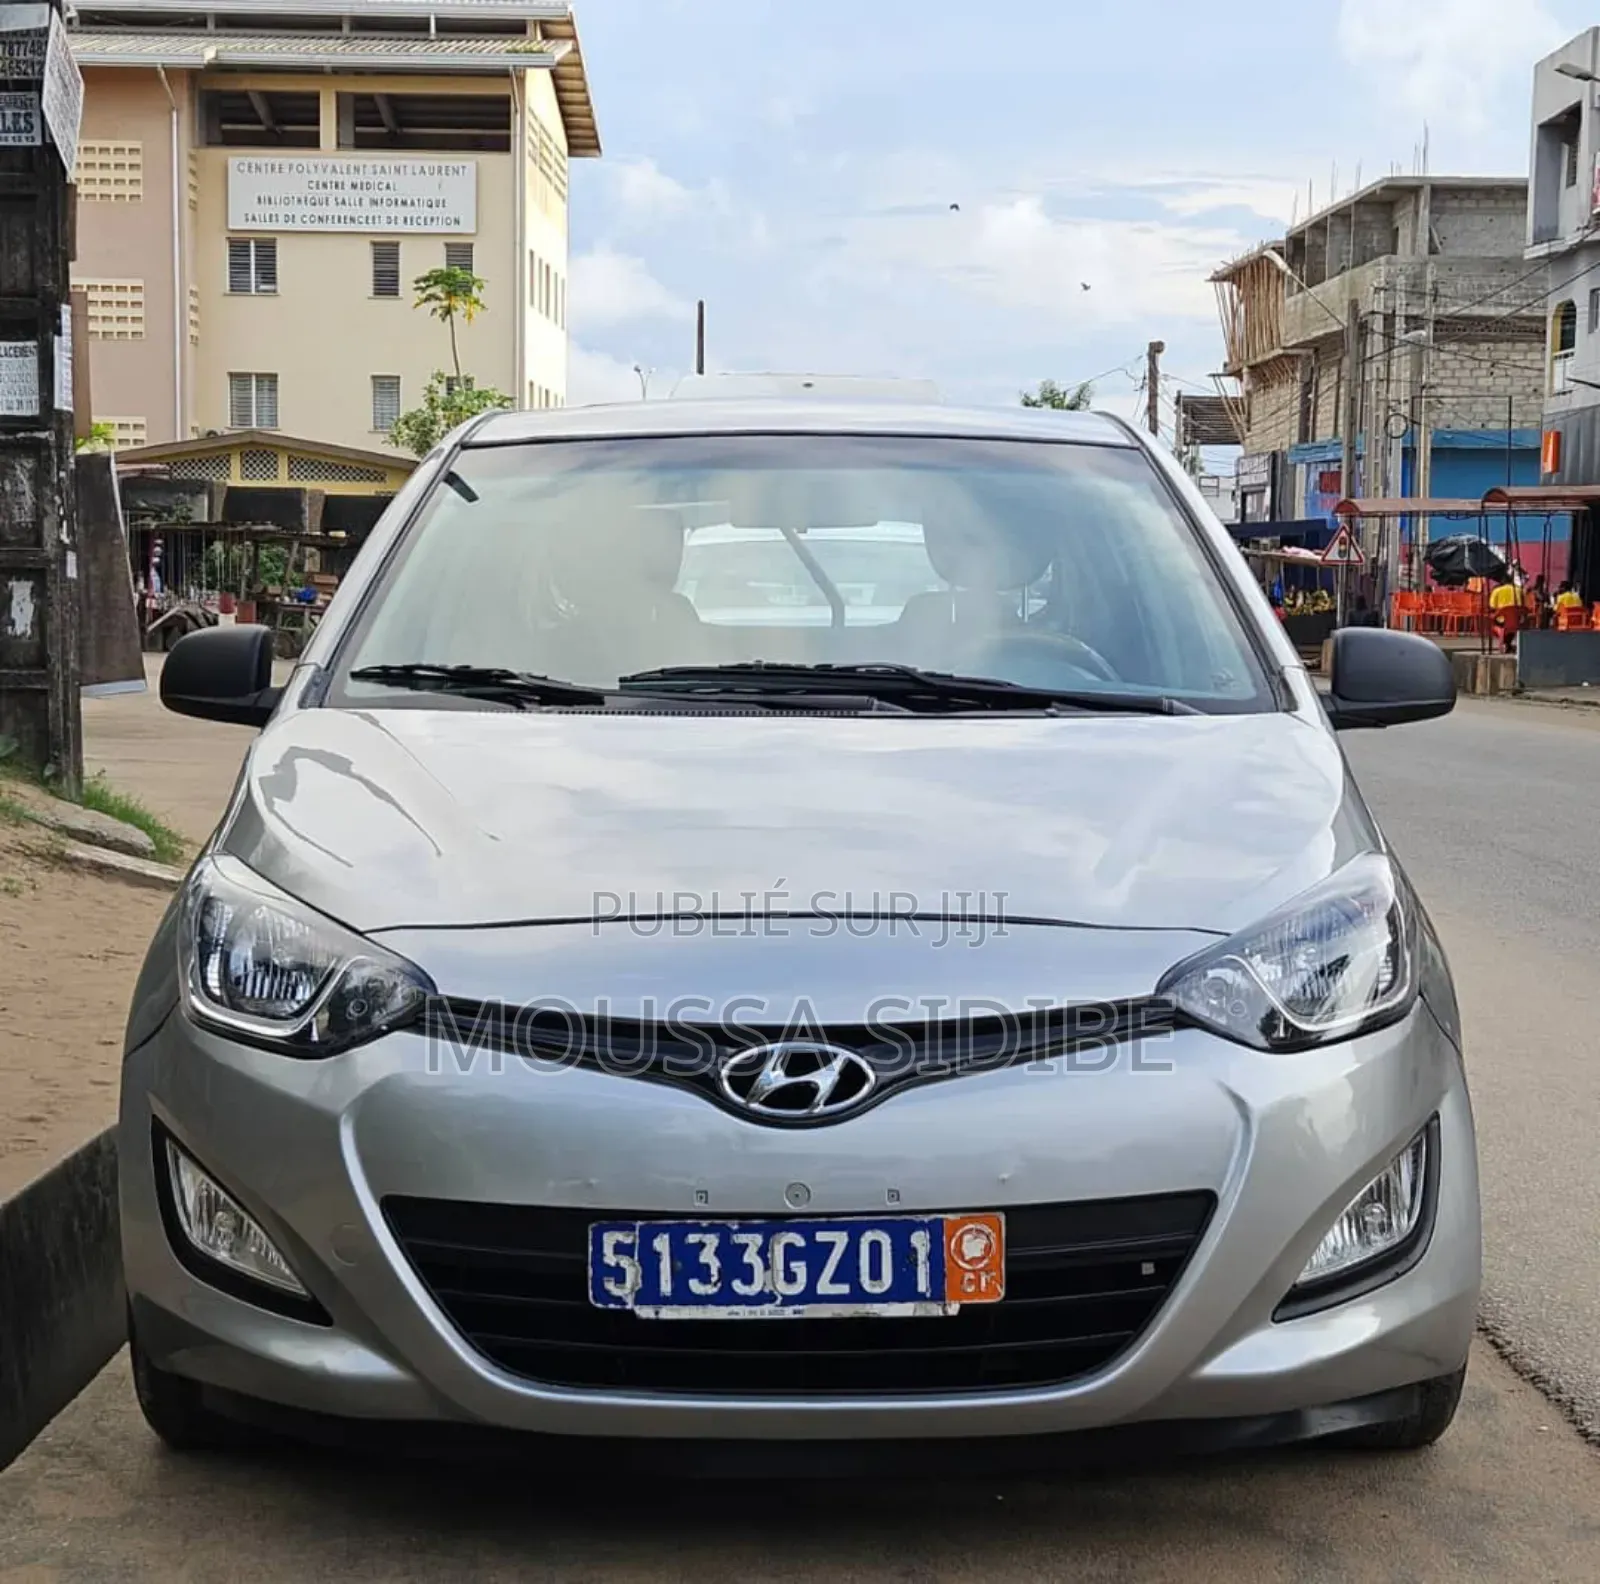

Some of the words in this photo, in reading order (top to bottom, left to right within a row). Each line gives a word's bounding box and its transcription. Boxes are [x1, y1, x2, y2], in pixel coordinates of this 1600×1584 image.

[236, 161, 286, 174] CENTRE
[288, 162, 367, 176] POLYVALENT
[371, 164, 408, 176] SAINT
[411, 165, 468, 177] LAURENT
[307, 179, 346, 191] CENTRE
[350, 180, 398, 192] MEDICAL
[334, 196, 364, 208] SALLE
[369, 197, 448, 210] INFORMATIQUE
[243, 212, 280, 224] SALLES
[283, 213, 297, 224] DE
[385, 215, 399, 226] DE
[402, 216, 461, 227] RECEPTION
[601, 1229, 932, 1298] 5133GZ01
